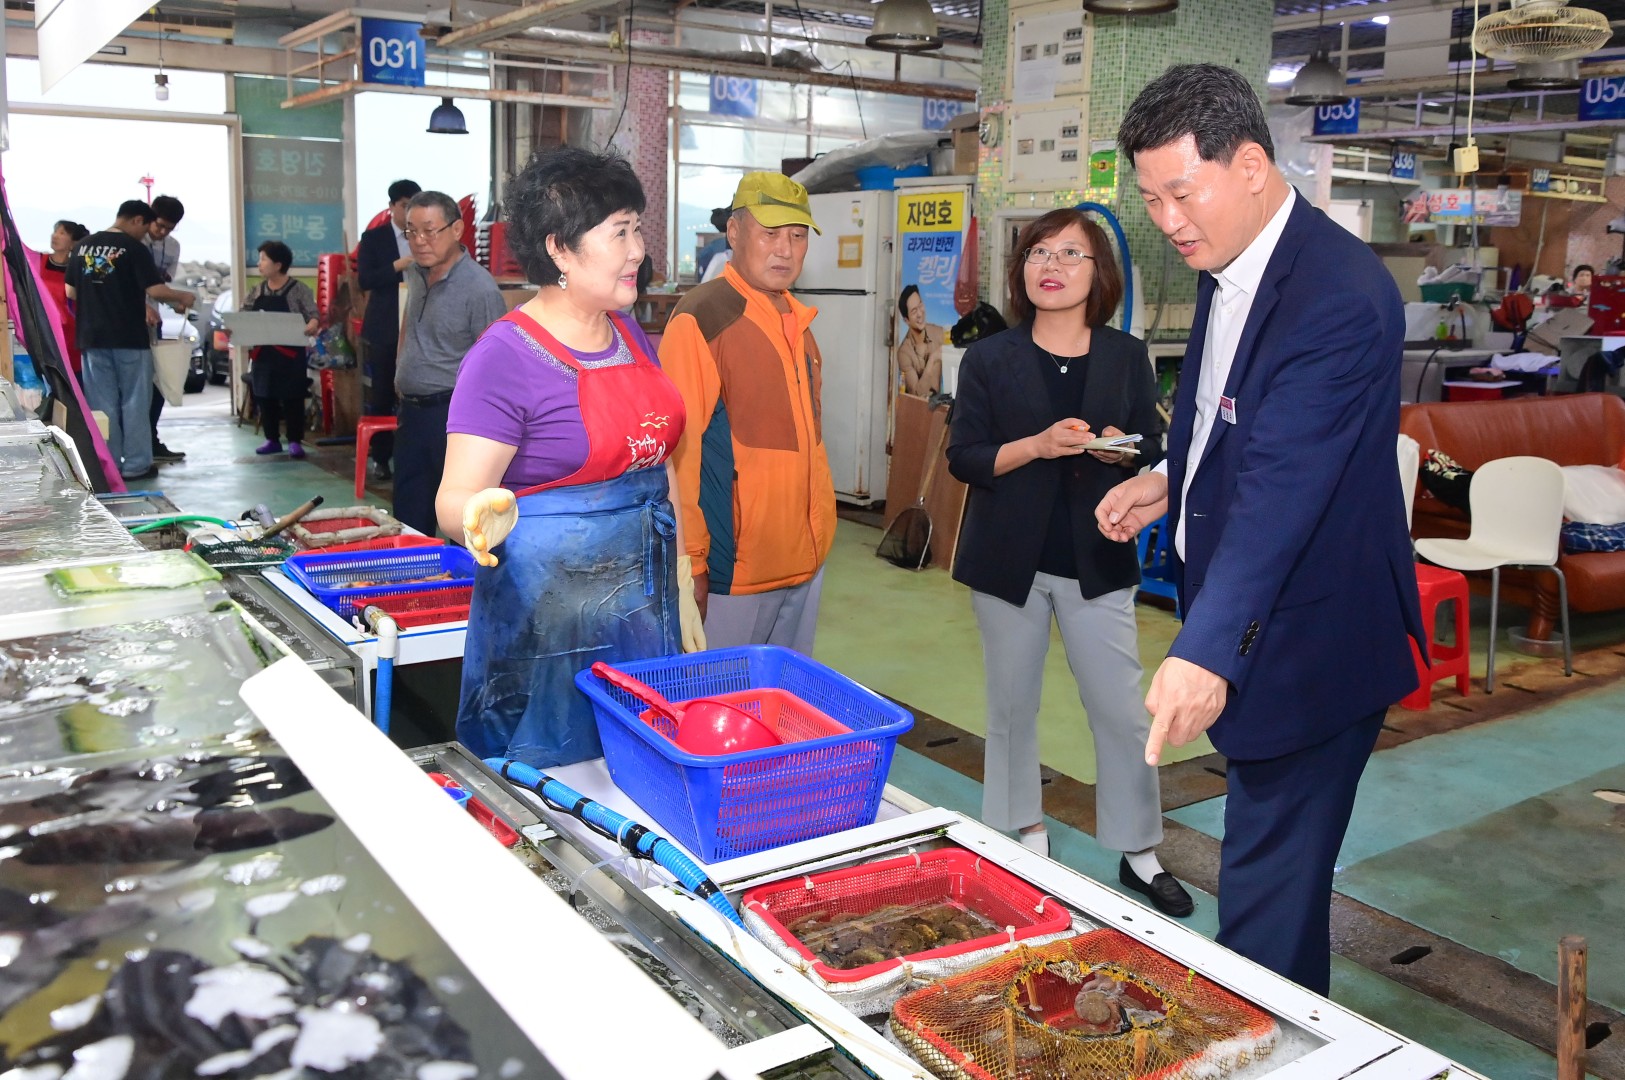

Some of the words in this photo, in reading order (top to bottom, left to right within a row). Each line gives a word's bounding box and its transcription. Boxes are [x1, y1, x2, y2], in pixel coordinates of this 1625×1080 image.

[370, 36, 416, 70] 031
[714, 75, 753, 102] 032
[906, 200, 952, 226] 자연호
[907, 236, 935, 252] 라거의
[935, 236, 955, 252] 반전
[917, 254, 957, 287] 켈리
